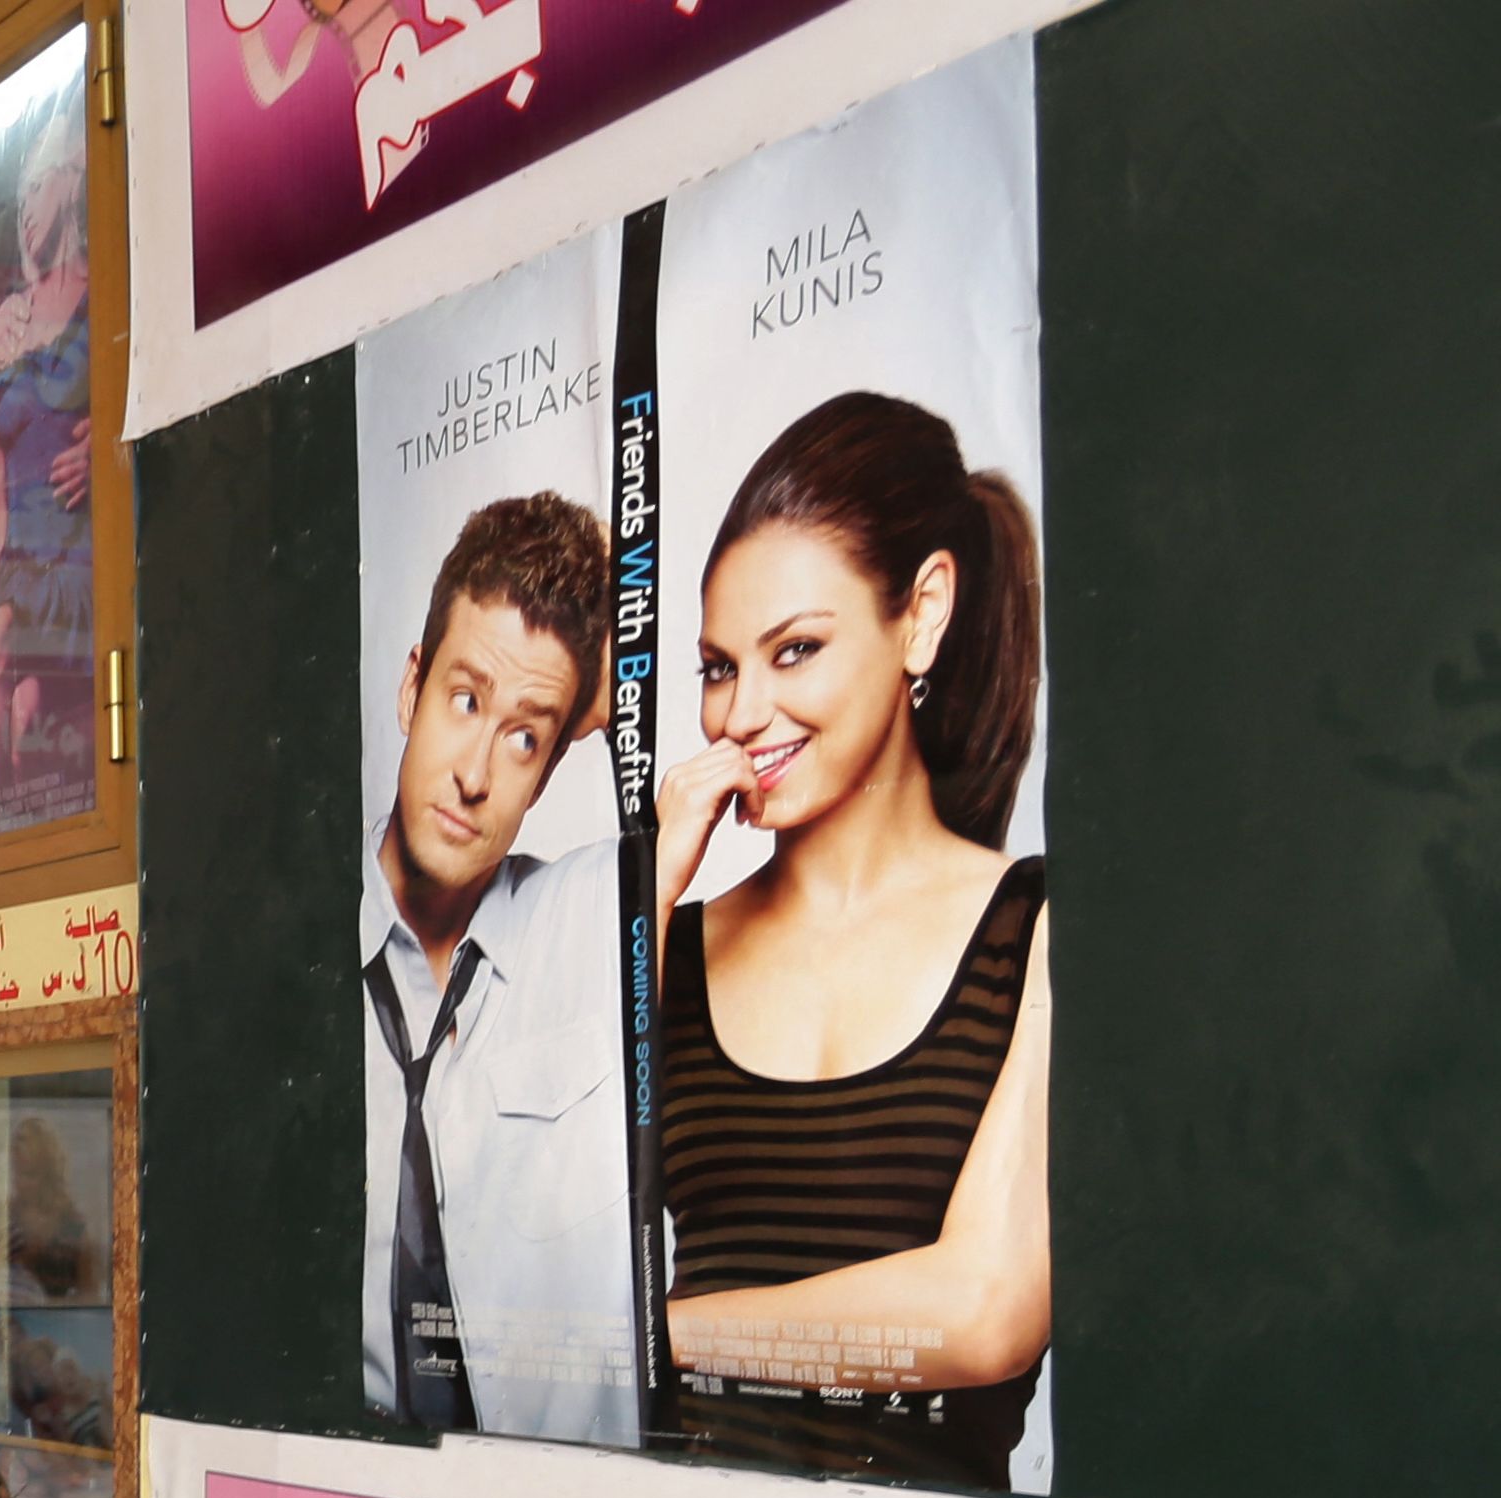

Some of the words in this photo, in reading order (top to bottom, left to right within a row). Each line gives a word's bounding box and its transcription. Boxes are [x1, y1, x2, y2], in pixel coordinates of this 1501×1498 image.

[750, 251, 885, 341] KUNIS
[764, 208, 873, 288] MILA
[396, 361, 604, 476] TIMBERLAKE
[437, 338, 558, 419] JUSTIN
[619, 390, 654, 540] Friends
[616, 540, 655, 645] With
[615, 652, 655, 816] Benefits
[631, 915, 650, 1034] COMING
[636, 1041, 651, 1126] SOON
[819, 1385, 864, 1399] SONY
